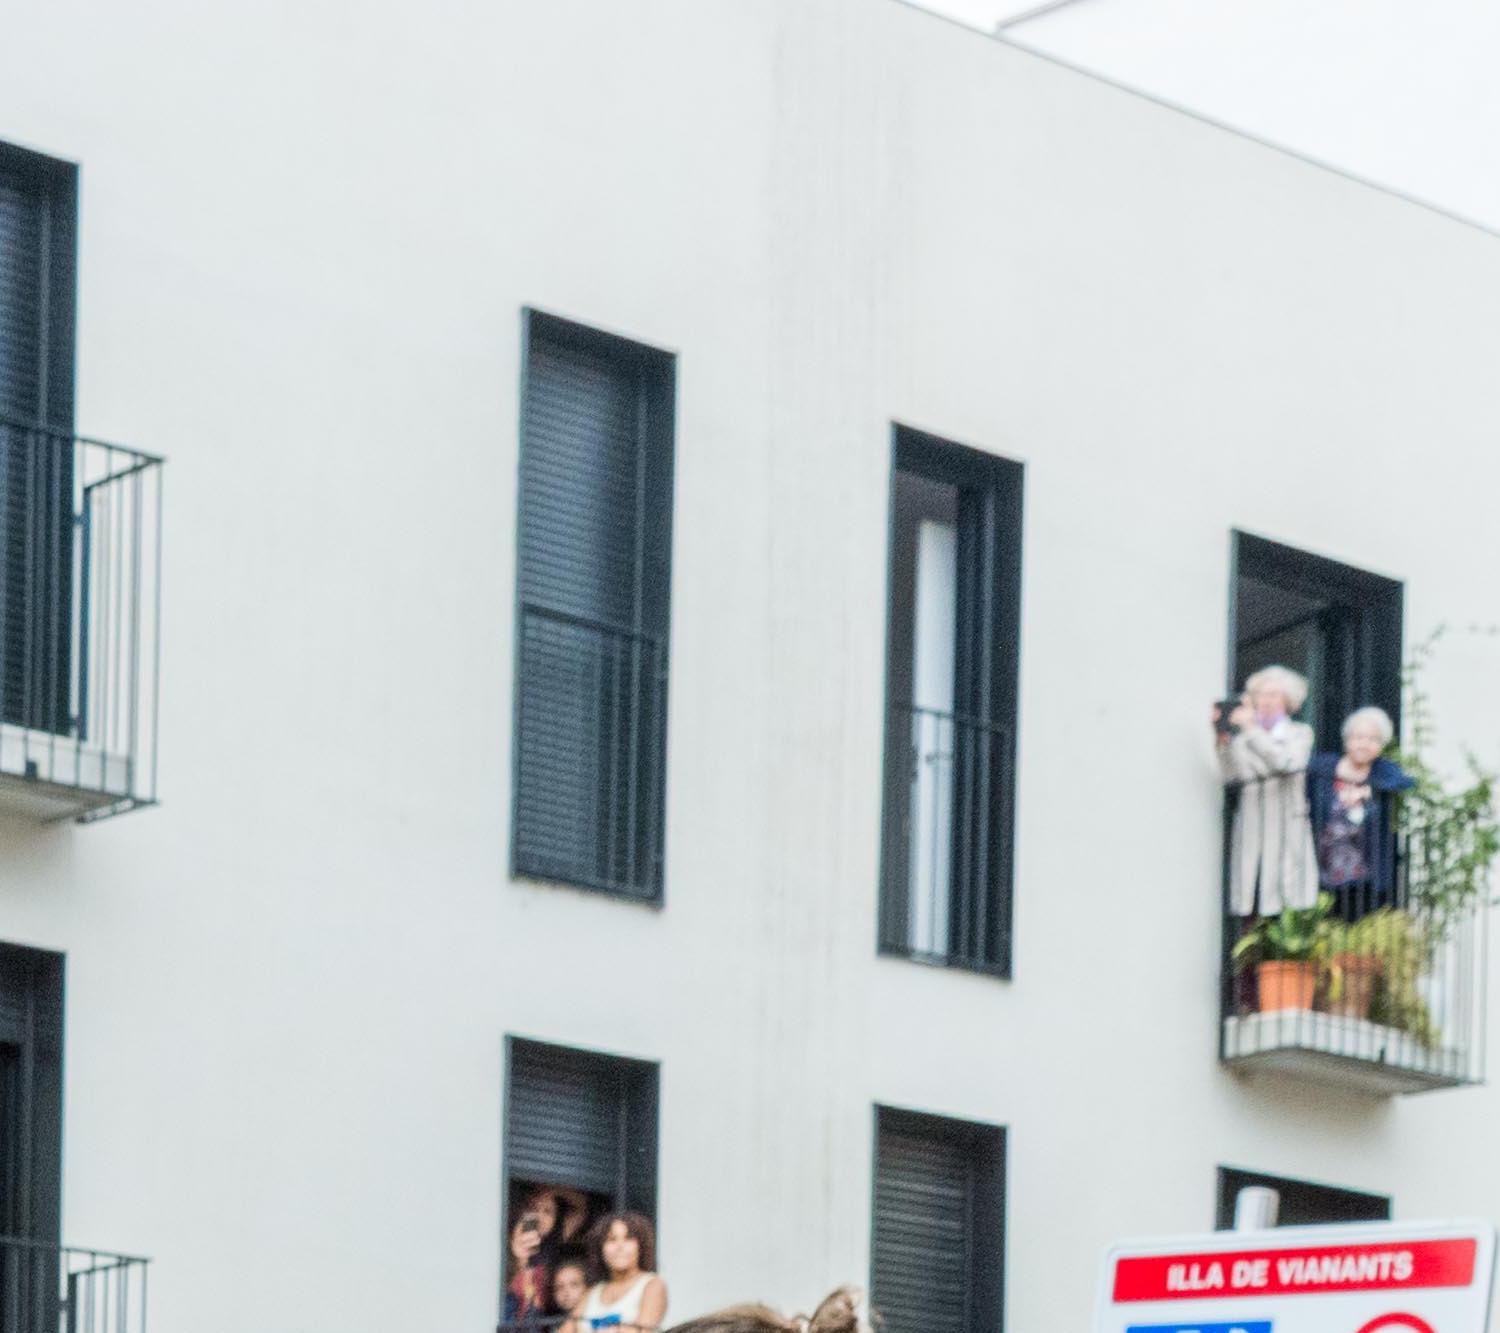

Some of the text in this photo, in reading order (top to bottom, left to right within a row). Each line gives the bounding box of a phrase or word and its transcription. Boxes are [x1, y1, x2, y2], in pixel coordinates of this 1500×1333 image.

[1166, 1250, 1415, 1292] ILLA DE VIANANTS
